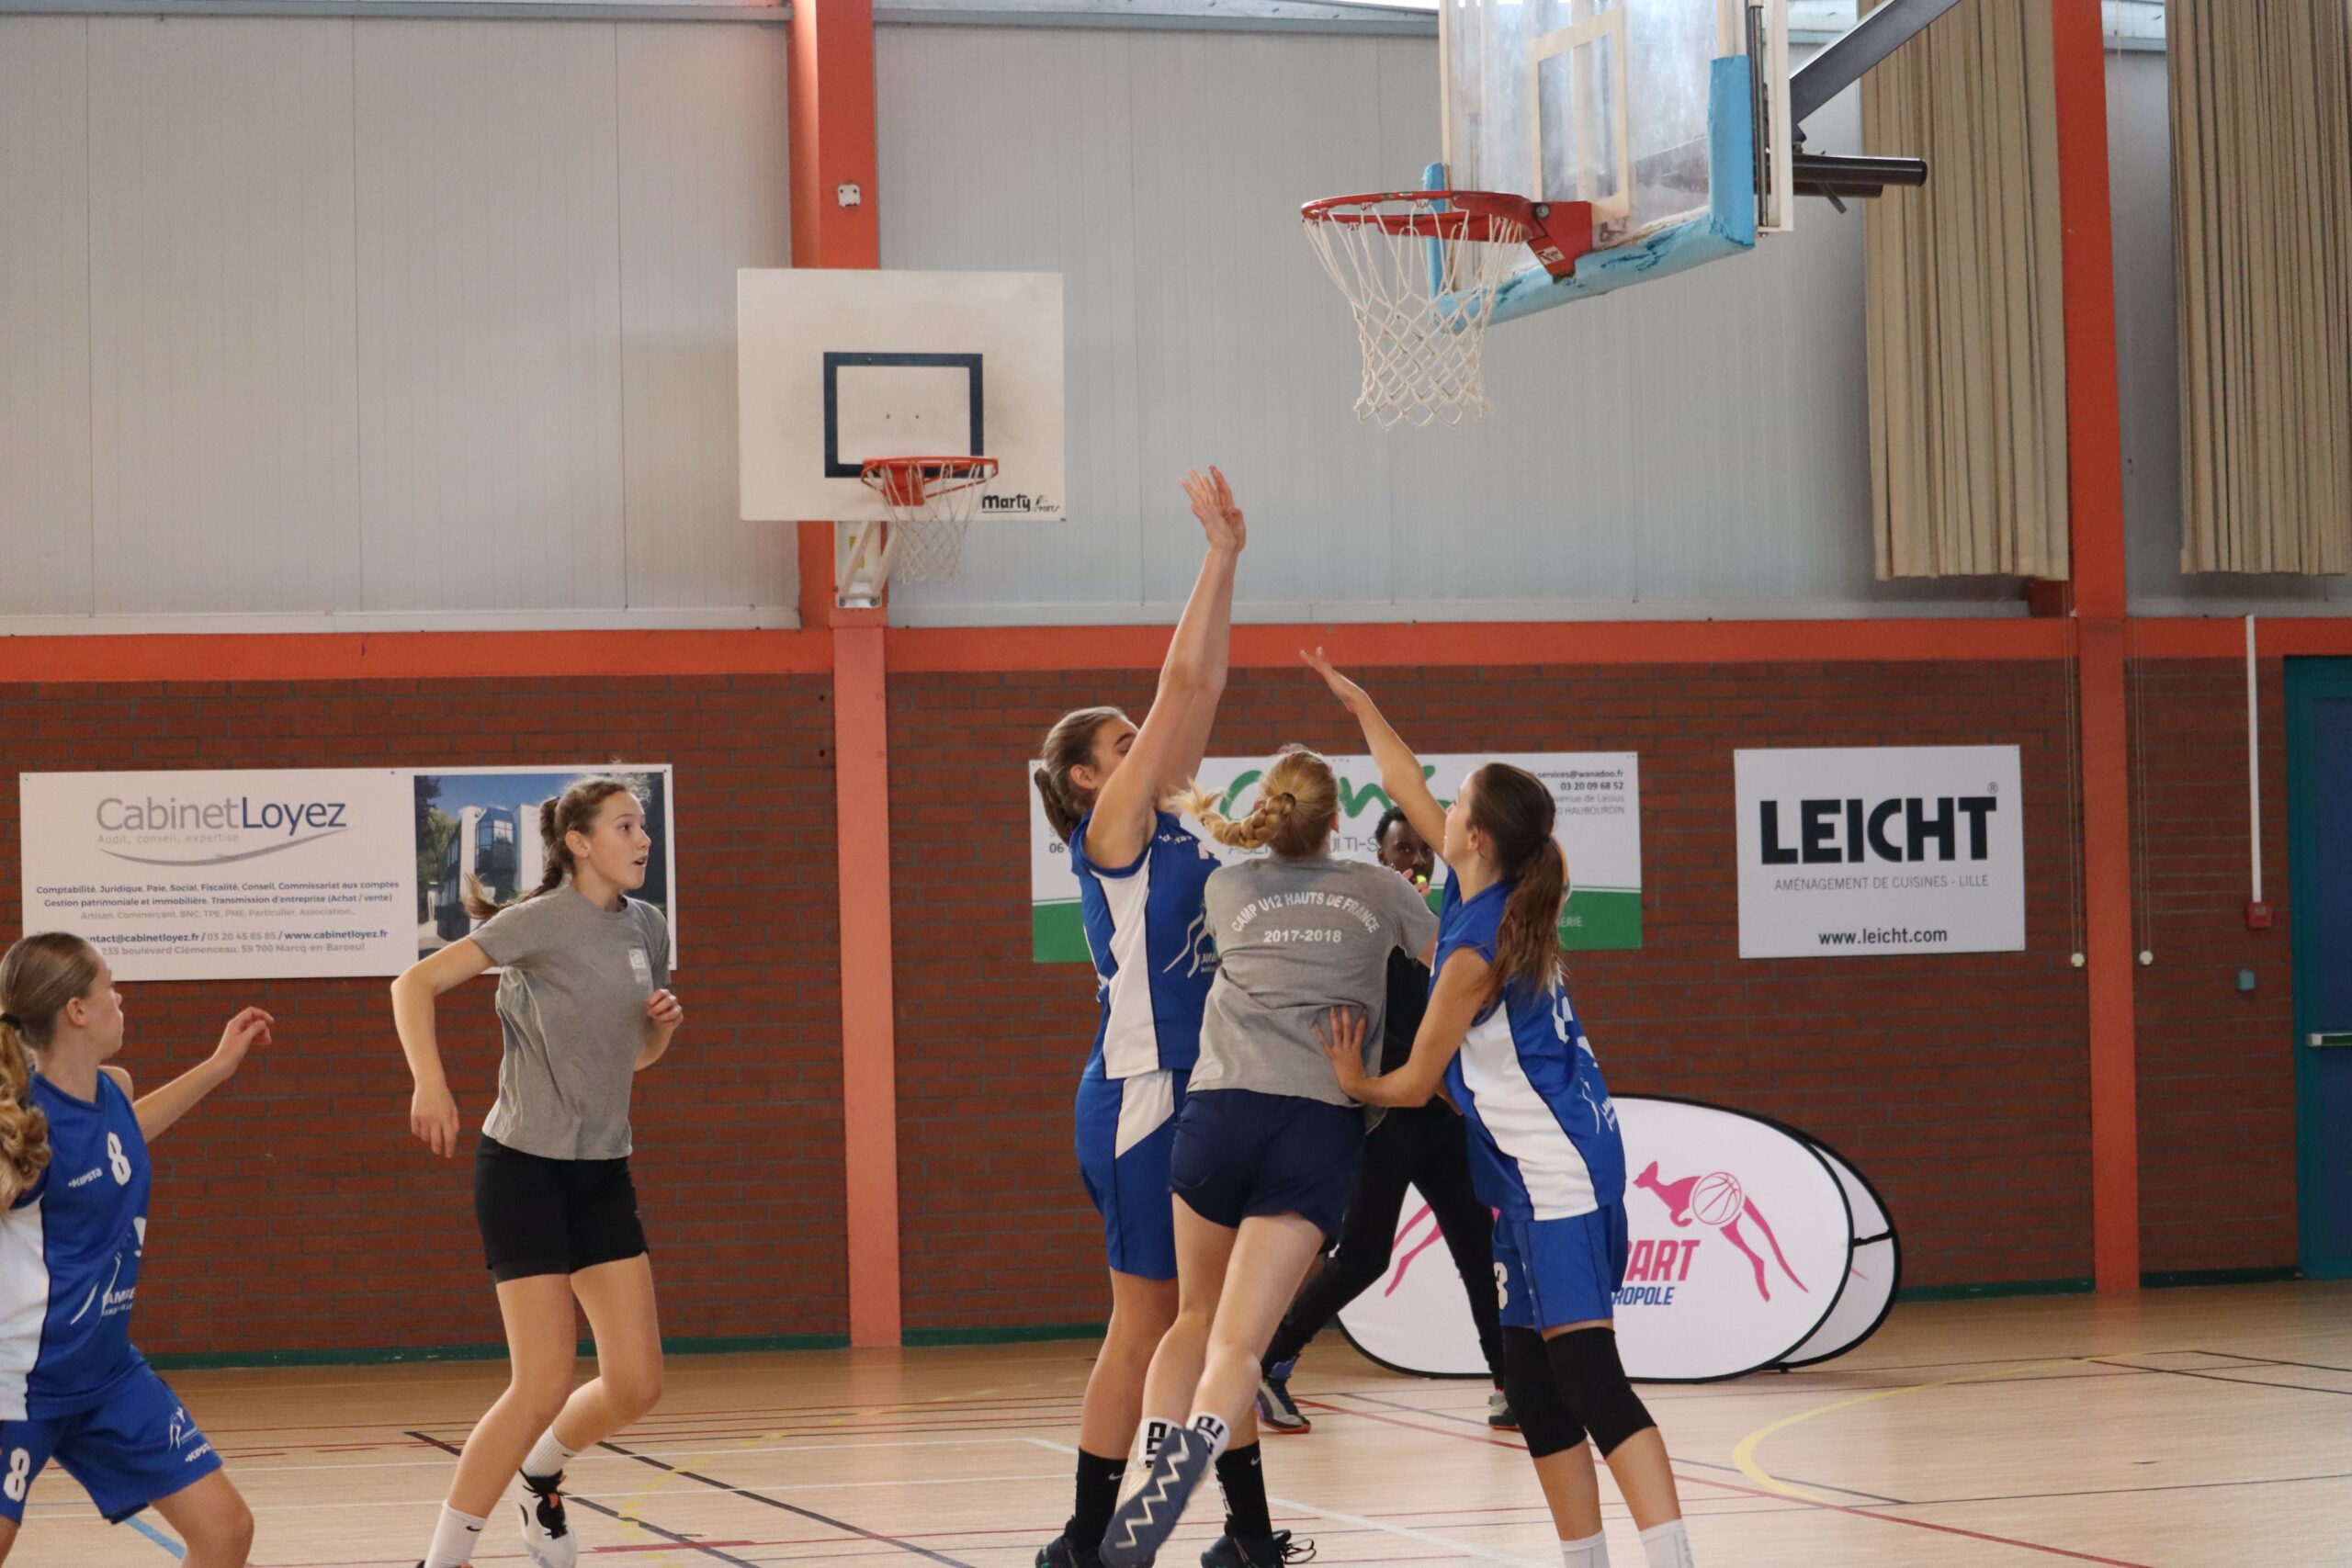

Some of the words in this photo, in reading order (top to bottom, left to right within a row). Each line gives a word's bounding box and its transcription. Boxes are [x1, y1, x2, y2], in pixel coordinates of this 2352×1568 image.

[981, 493, 1031, 512] Marty
[1560, 782, 1571, 790] 03
[1574, 782, 1585, 790] 20
[1587, 782, 1598, 790] 09
[1600, 782, 1611, 790] 68
[1613, 781, 1623, 790] 52
[1583, 795, 1594, 803] de
[1598, 795, 1624, 803] Lassus
[1565, 807, 1624, 816] HAUBOURDIN
[186, 832, 239, 845] expertise
[1049, 843, 1064, 853] 06
[278, 881, 340, 890] Commissariat
[360, 882, 400, 891] comptes
[1774, 876, 1869, 891] AMÉNAGEMENT
[1872, 877, 1888, 889] DE
[1893, 875, 1948, 889] CUISINES
[1958, 874, 1989, 887] LILLE
[44, 898, 79, 908] Gestion
[81, 897, 139, 908] patrimoniale
[141, 897, 150, 906] et
[211, 896, 270, 905] Transmission
[364, 894, 392, 903] vente)
[1231, 904, 1257, 932] CAMP
[1258, 895, 1282, 912] U12
[1284, 892, 1325, 907] HAUTS
[1326, 894, 1344, 908] DE
[1342, 897, 1379, 934] FRANCE
[89, 932, 199, 944] ntact@cabinetloyez.fr
[284, 929, 388, 941] www.cabinetloyez.fr
[1263, 929, 1342, 943] 2017-2018
[1818, 927, 1948, 945] www.leicht.com
[121, 946, 173, 955] boulevard
[255, 944, 274, 953] 700
[107, 1131, 131, 1187] 8
[1625, 1239, 1702, 1282] ART
[1612, 1286, 1676, 1306] ROPOLE
[4, 1447, 30, 1503] 8
